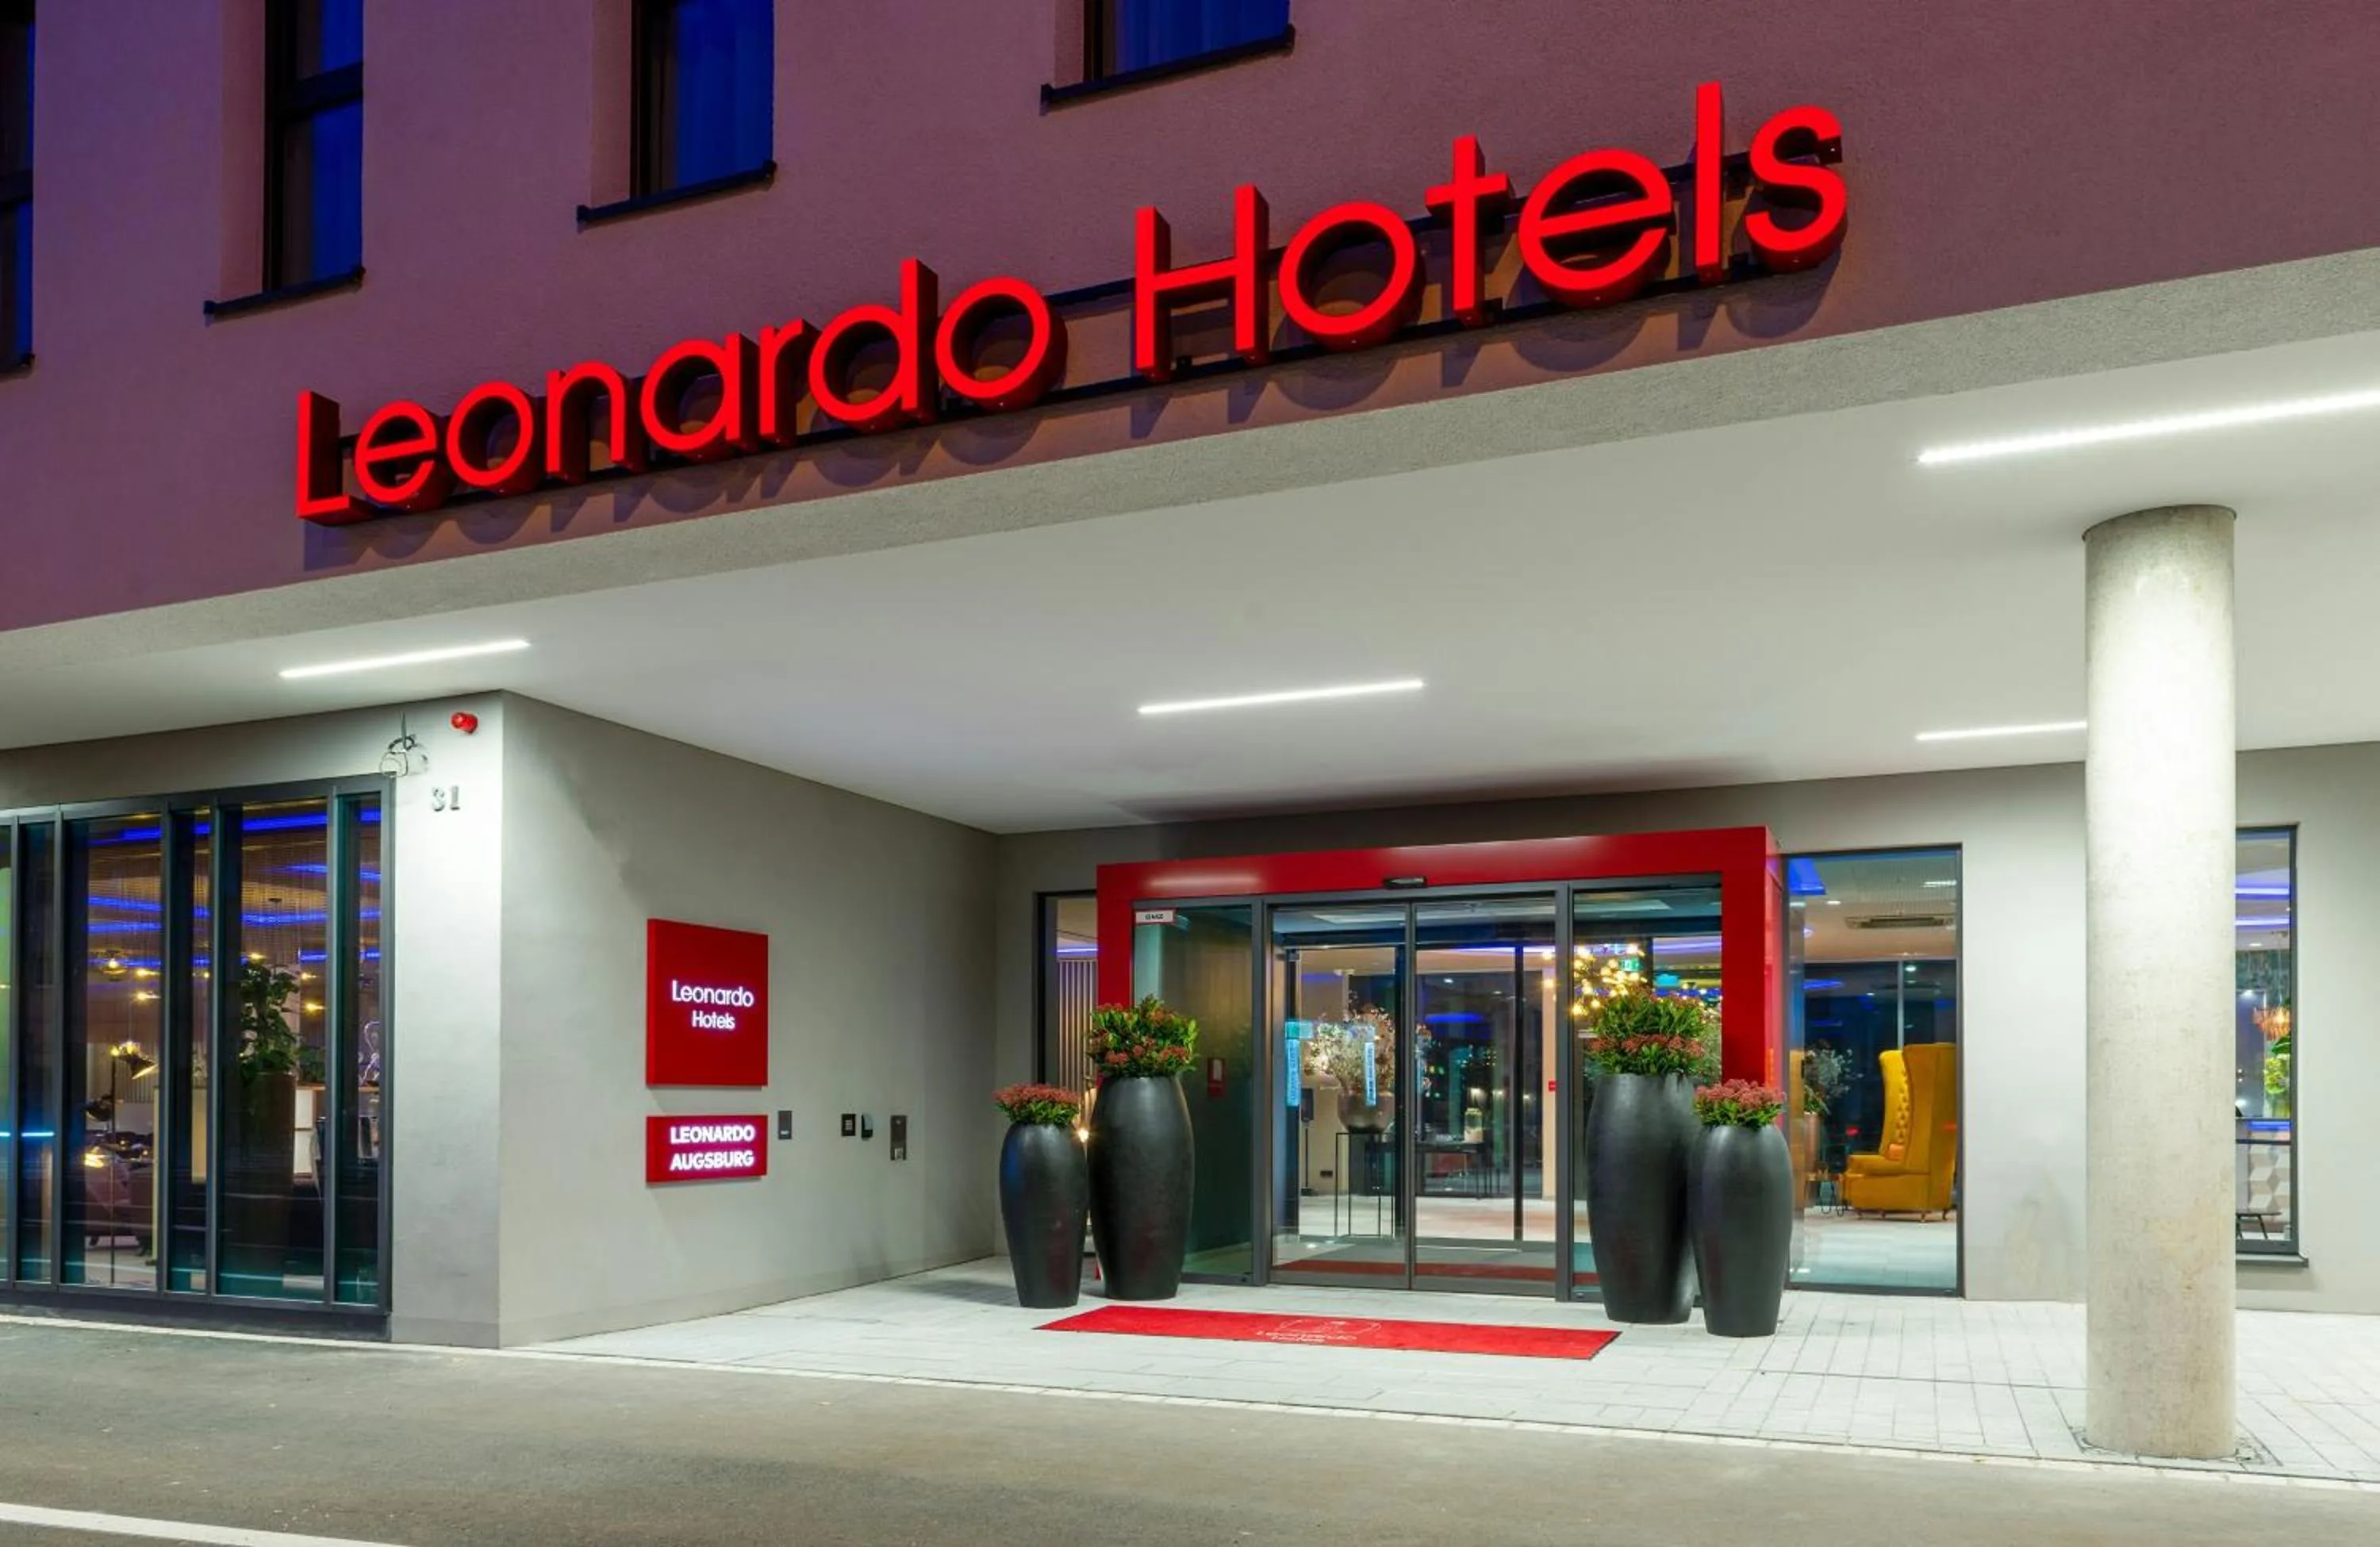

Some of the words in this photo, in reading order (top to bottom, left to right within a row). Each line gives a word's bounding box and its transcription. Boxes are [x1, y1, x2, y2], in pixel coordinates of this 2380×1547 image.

[295, 257, 1055, 520] Leonardo
[1135, 81, 1848, 374] Hotels
[671, 980, 754, 1008] Leonardo
[691, 1010, 735, 1030] Hotels
[670, 1124, 755, 1144] LEONARDO
[670, 1150, 754, 1171] AUGSBURG
